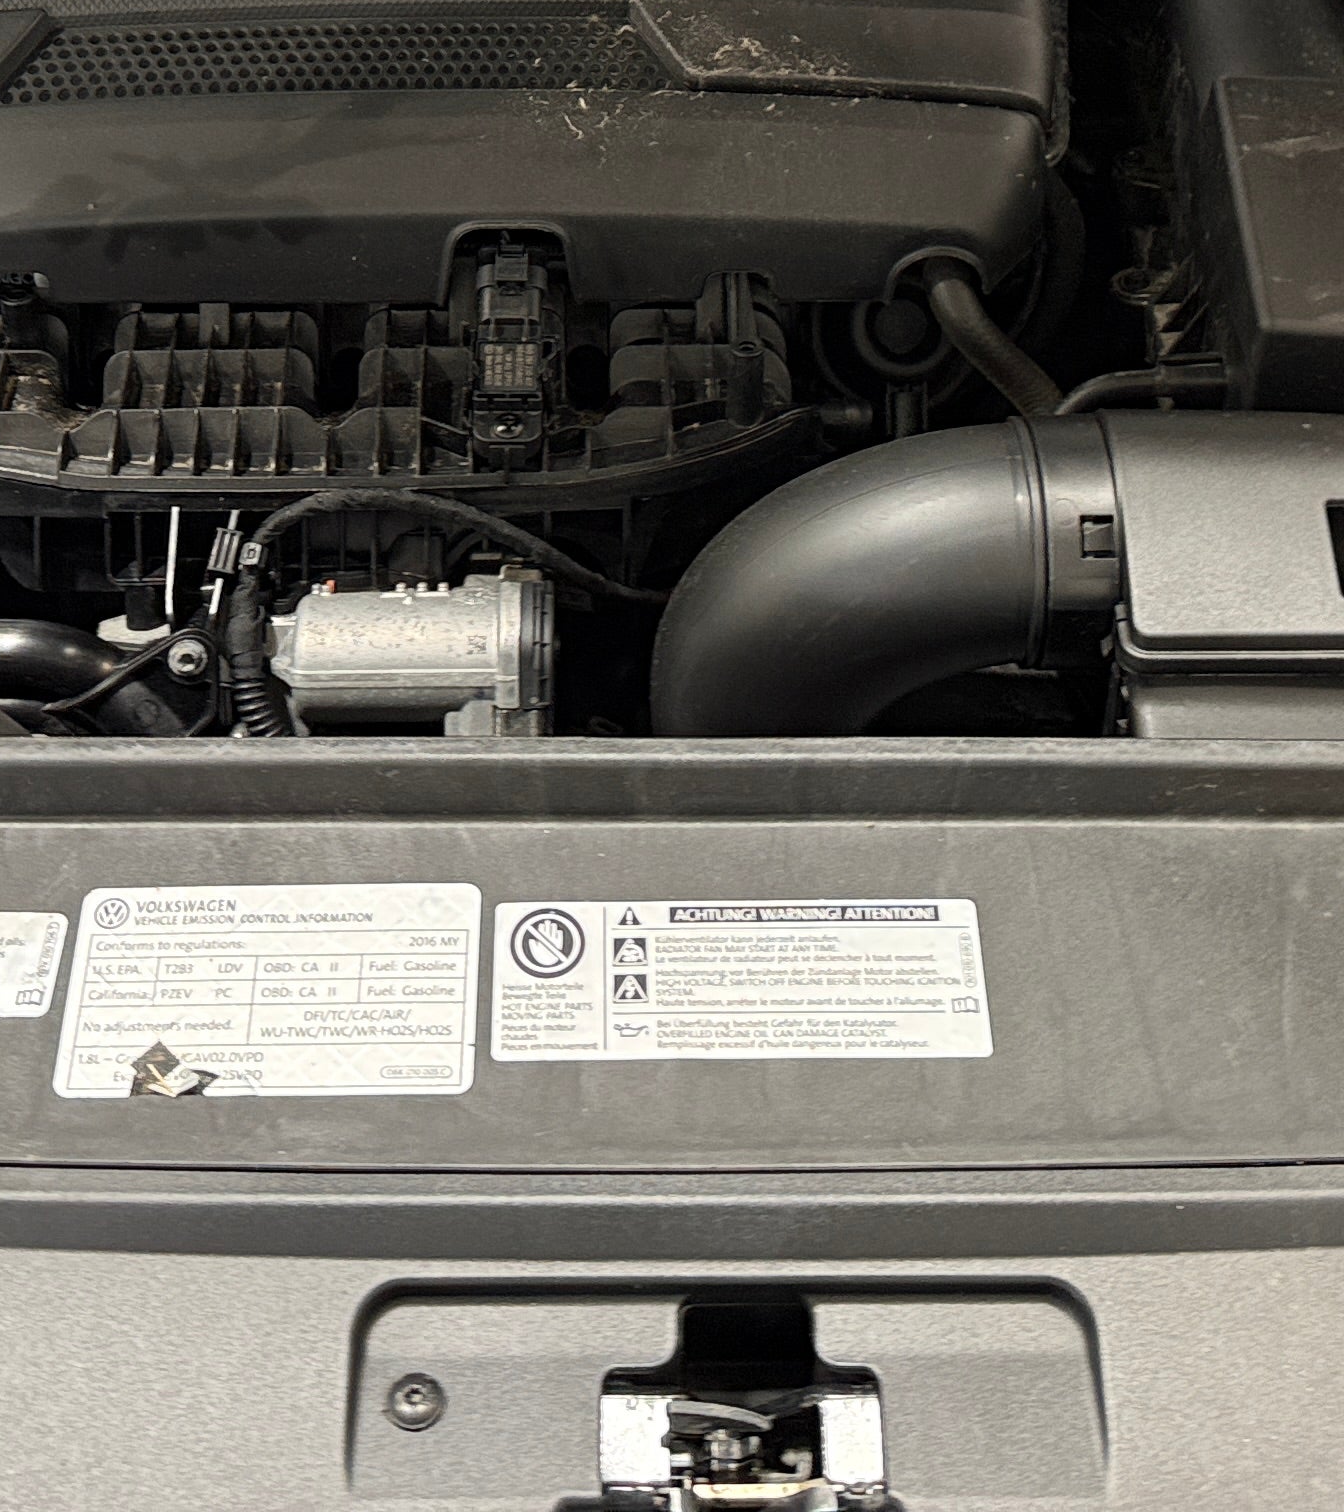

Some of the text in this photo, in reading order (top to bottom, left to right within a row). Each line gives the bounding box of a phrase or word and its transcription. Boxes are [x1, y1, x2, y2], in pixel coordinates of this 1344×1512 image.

[136, 899, 238, 913] VOLKSWAGEN
[134, 912, 374, 926] VEHICLE EMISSION CONTROL INFORMATION
[673, 906, 936, 921] ACHTUNG! WARNING! ATTENTION!
[96, 940, 155, 952] Conforms
[158, 939, 171, 950] to
[408, 936, 459, 947] 2016 MY
[218, 963, 243, 973] LDV
[263, 963, 295, 973] OBD:
[301, 962, 319, 972] CA
[369, 960, 457, 971] Fuel: Gasoline
[160, 988, 233, 999] PZEV PC
[261, 987, 293, 998] OBD:
[299, 987, 316, 997] CA
[367, 985, 456, 997] Fuel: Gasoline
[82, 1021, 102, 1032] No
[104, 1020, 181, 1035] adjustments
